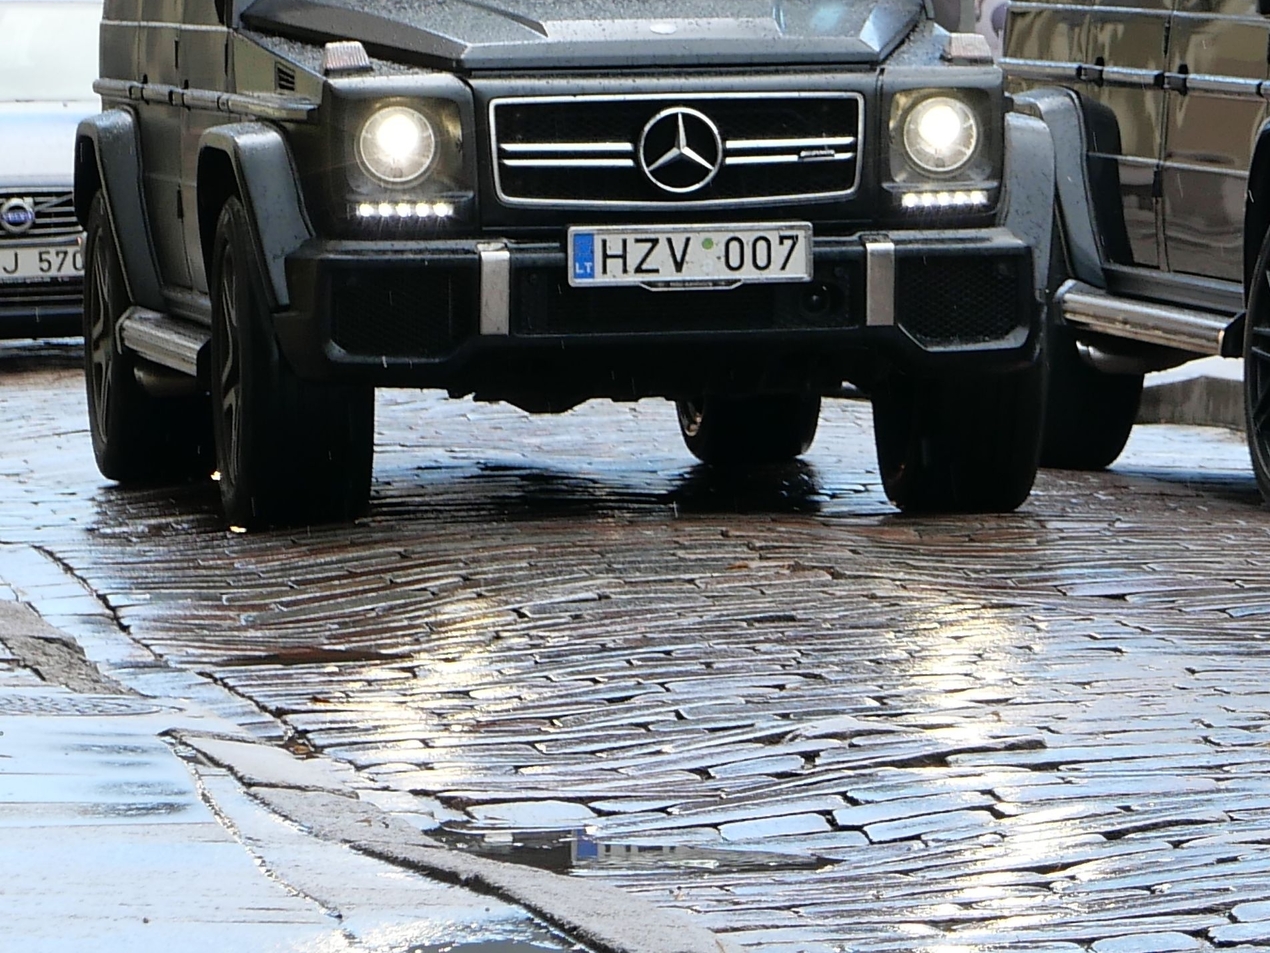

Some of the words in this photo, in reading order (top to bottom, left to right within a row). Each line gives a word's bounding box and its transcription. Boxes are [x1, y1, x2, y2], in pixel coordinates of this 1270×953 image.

[575, 262, 593, 274] LT
[601, 236, 691, 275] HZV
[724, 234, 799, 272] 007
